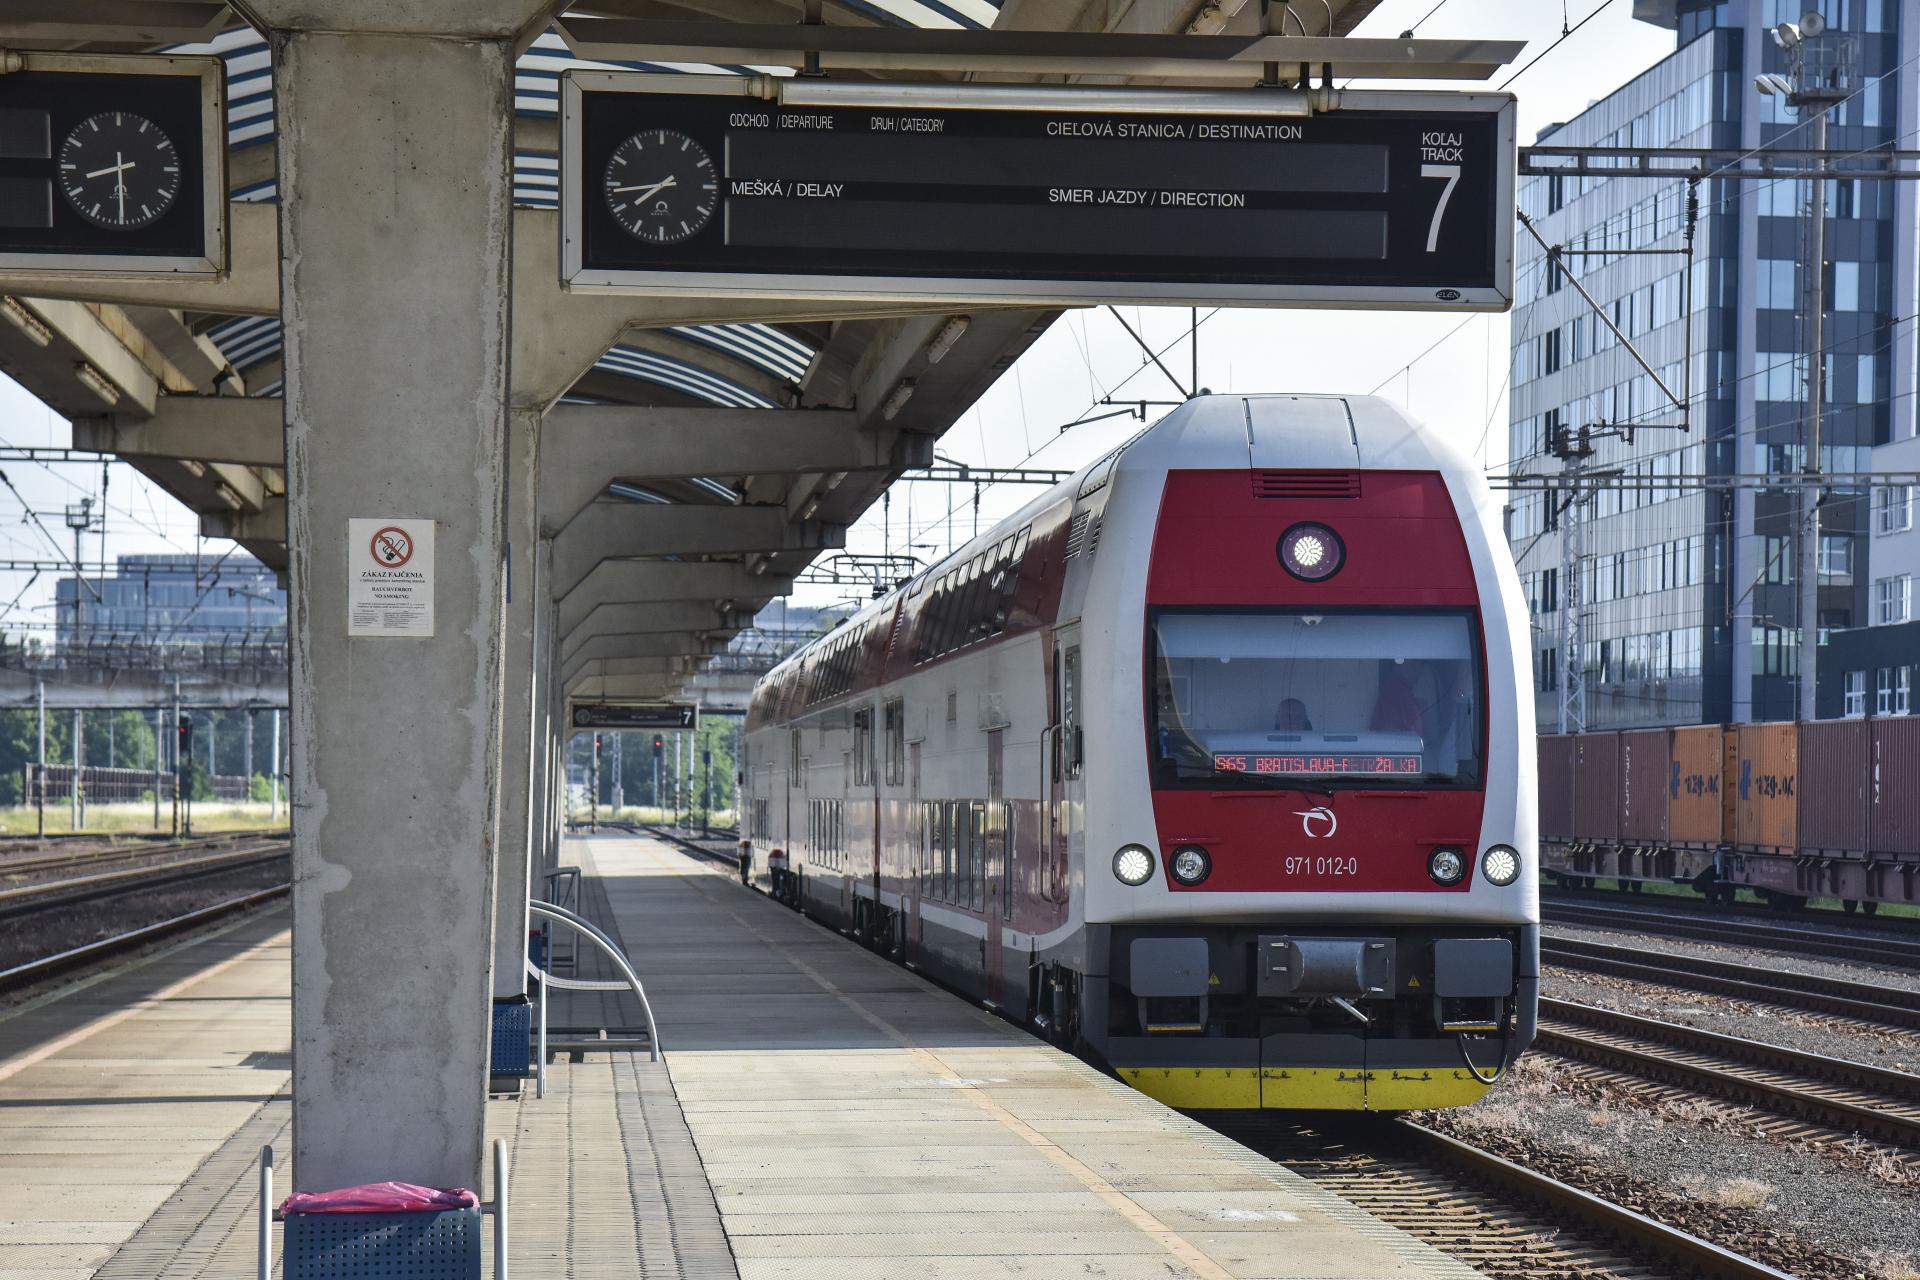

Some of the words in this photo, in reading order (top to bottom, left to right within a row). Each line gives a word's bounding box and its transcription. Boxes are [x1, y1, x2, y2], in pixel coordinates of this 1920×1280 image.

[729, 113, 769, 128] ODCHOD
[781, 115, 834, 129] DEPARTURE
[871, 116, 894, 131] DRUH
[900, 117, 945, 132] CATEGORY
[1046, 120, 1114, 137] CIEĽOVÁ
[1117, 123, 1185, 138] STANICA
[1198, 124, 1303, 139] DESTINATION
[1422, 132, 1462, 146] KOĽAJ
[1420, 147, 1463, 161] TRACK
[731, 179, 783, 196] MEŠKÁ
[796, 183, 844, 197] DELAY
[1049, 188, 1094, 203] SMER
[1097, 190, 1148, 205] JAZDY
[1160, 191, 1245, 207] DIRECTION
[1421, 164, 1461, 252] 7
[361, 570, 387, 578] ZÁKAZ
[683, 711, 692, 725] 7
[1215, 756, 1247, 772] S65
[1285, 856, 1311, 876] 971
[1316, 857, 1357, 876] 012-0
